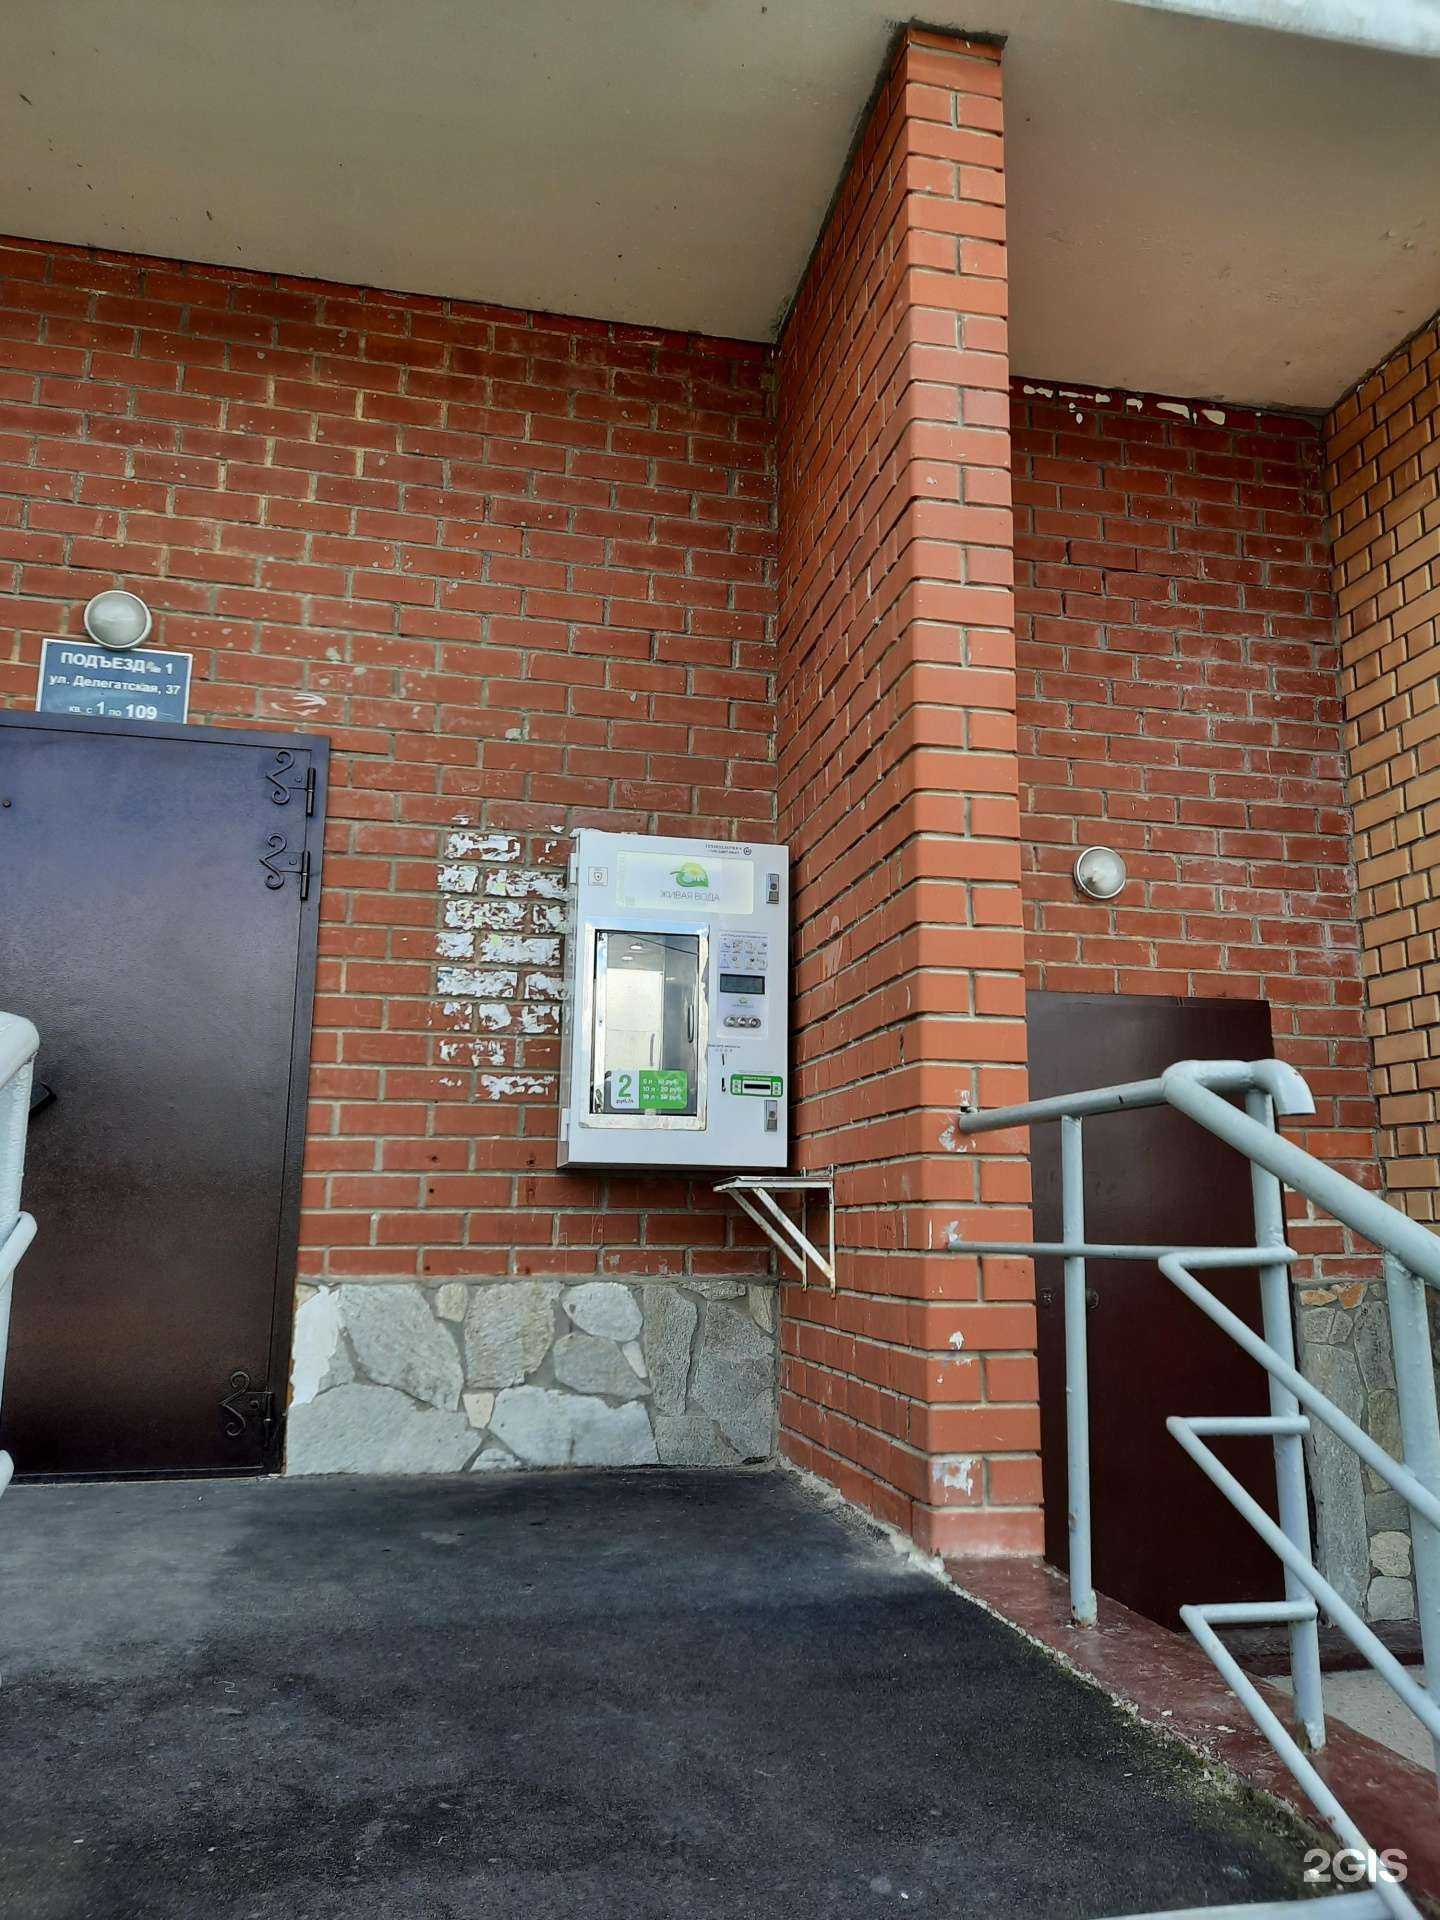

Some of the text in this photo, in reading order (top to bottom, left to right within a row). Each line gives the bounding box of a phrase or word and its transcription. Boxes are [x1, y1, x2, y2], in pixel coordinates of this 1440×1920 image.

[60, 652, 145, 673] ПОДЪЕЗД
[165, 663, 173, 674] 1
[49, 675, 182, 695] ул. Делегатская, 37
[96, 701, 105, 715] 1
[108, 709, 121, 717] по
[126, 704, 158, 720] 109
[659, 889, 721, 902] ЖИВАЯ ВОДА
[617, 1074, 632, 1098] 2
